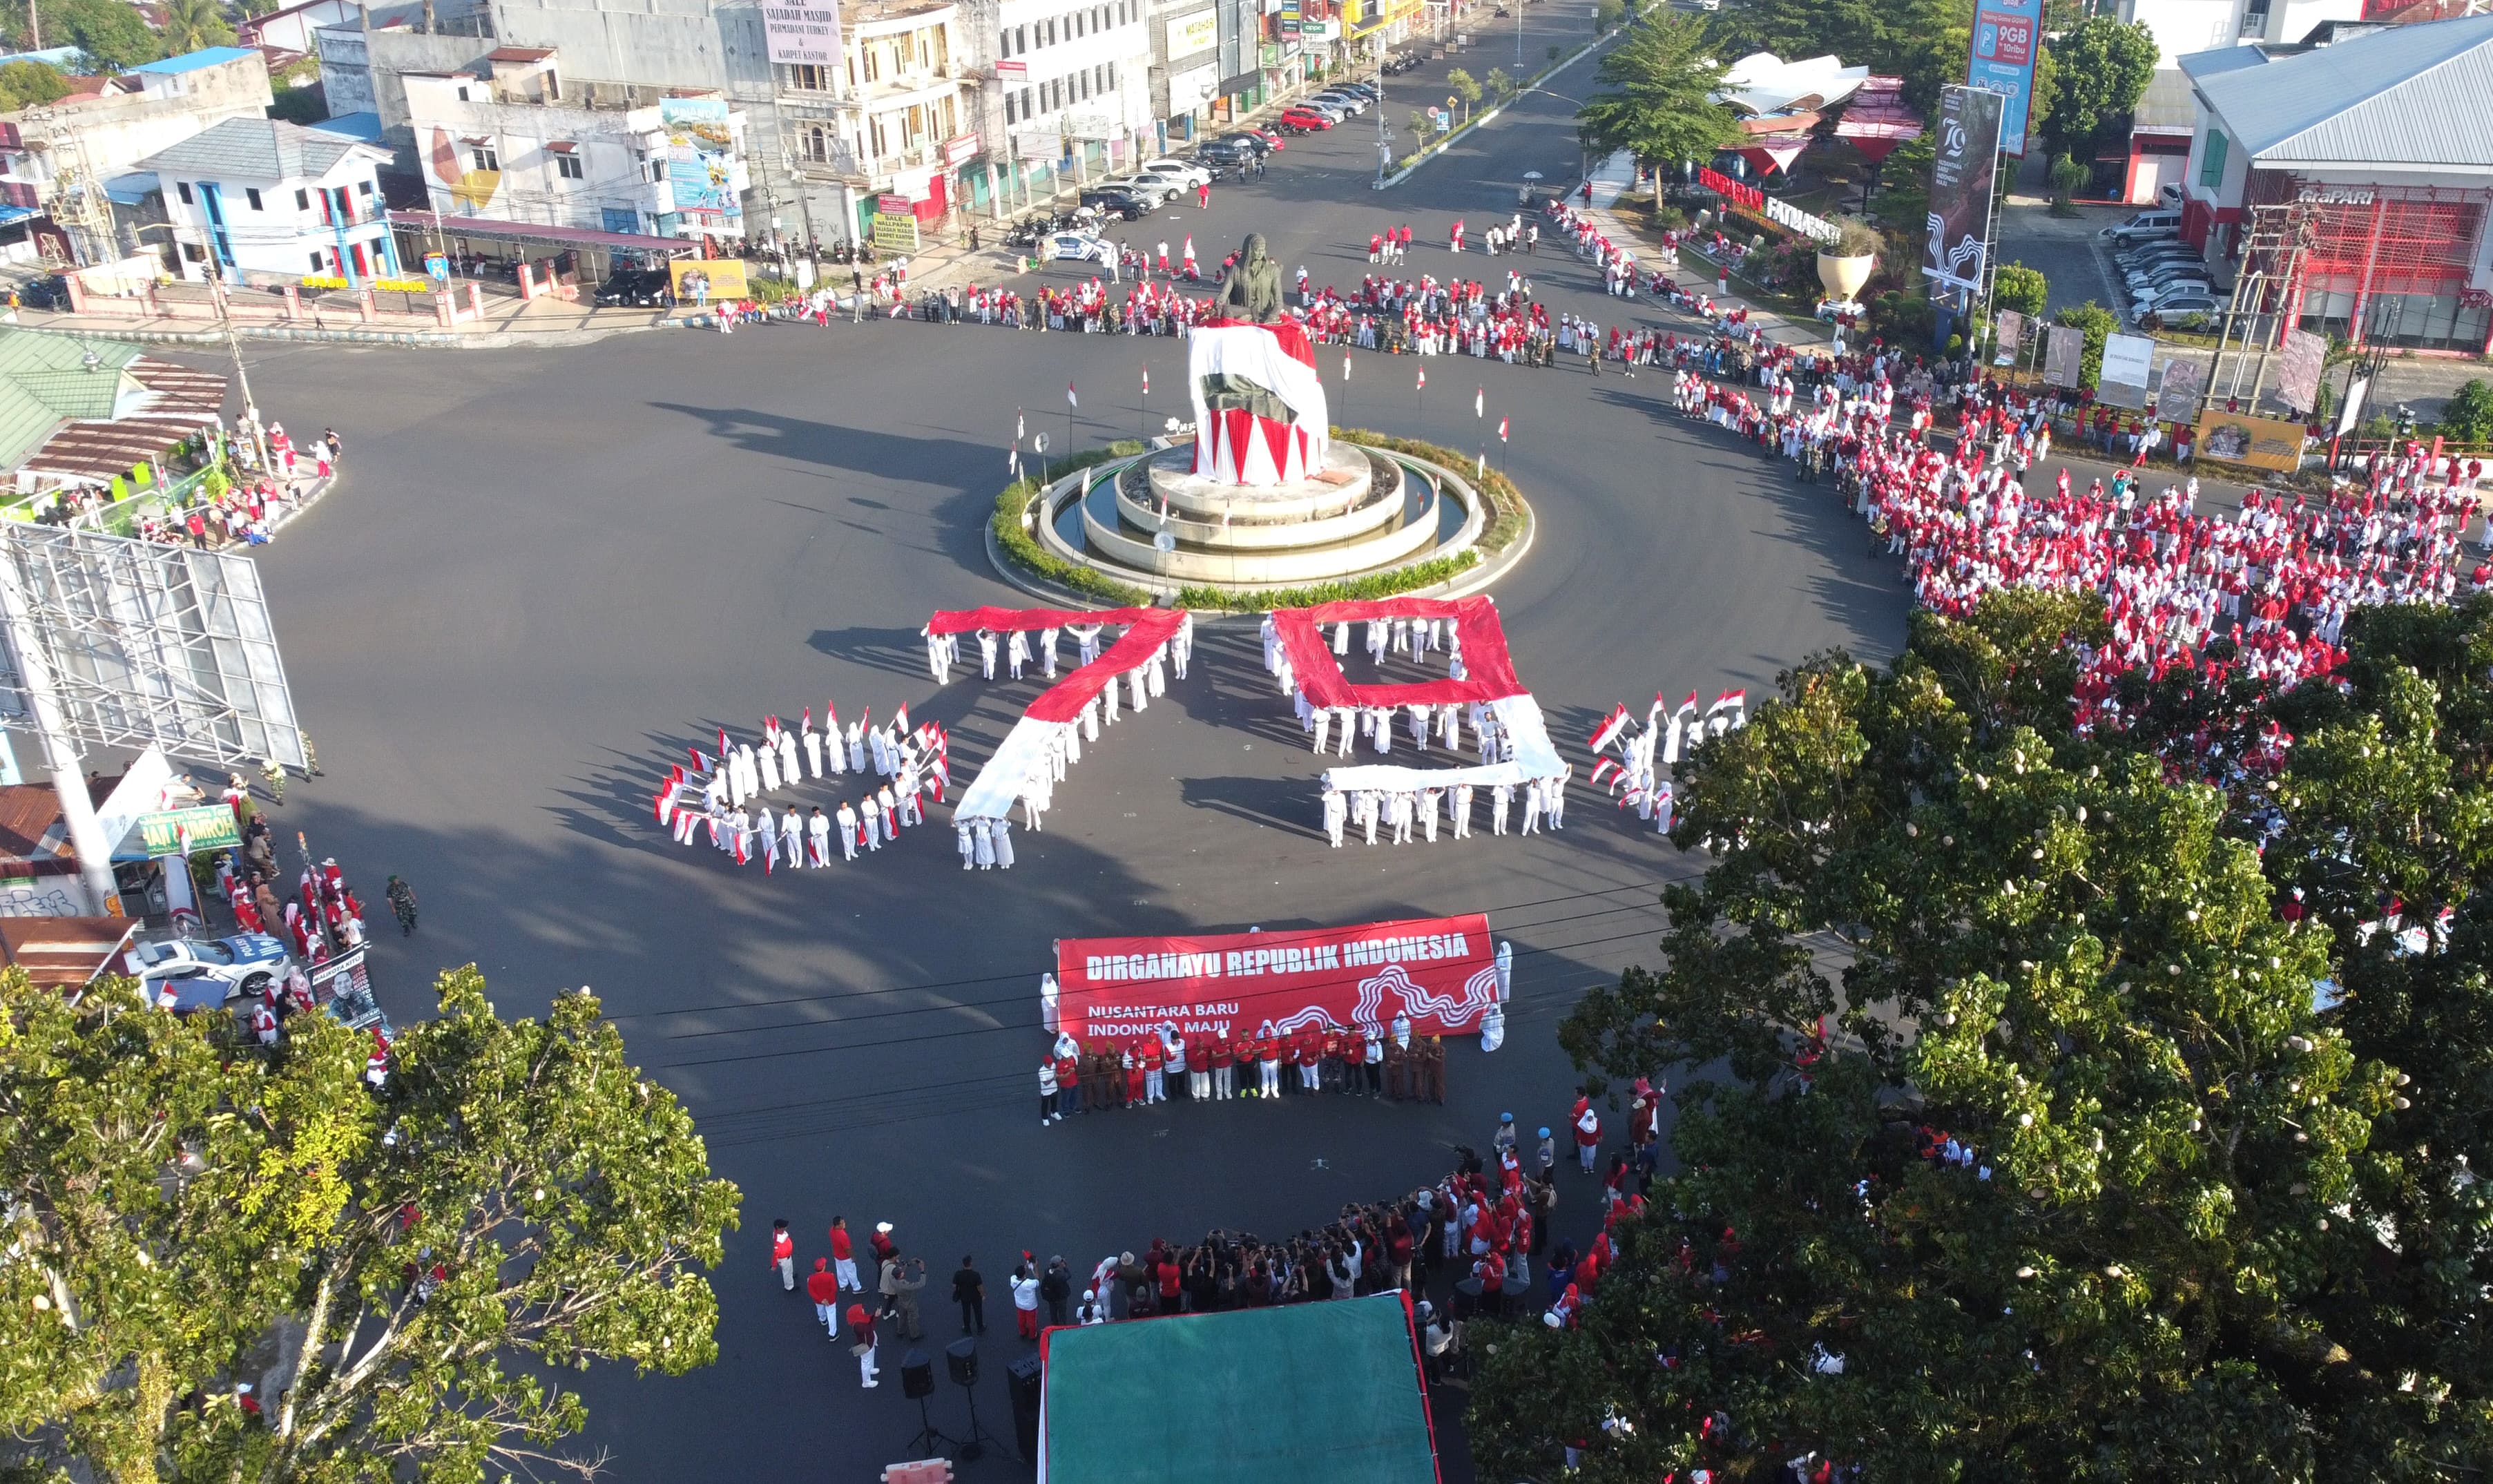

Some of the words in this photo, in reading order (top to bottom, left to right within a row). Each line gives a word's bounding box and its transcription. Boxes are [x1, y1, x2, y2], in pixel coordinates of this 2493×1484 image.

[767, 8, 801, 21] SAJADAH
[803, 10, 831, 23] MASJID
[770, 23, 805, 34] PERMADANI
[807, 25, 829, 35] TURKEY
[1999, 26, 2028, 44] 9GB
[778, 49, 801, 59] KARPET
[803, 50, 827, 61] KANTOR
[2003, 43, 2025, 55] 10ribu
[2298, 189, 2374, 205] GraPARI
[235, 938, 256, 956] POLISI
[1086, 953, 1220, 981] DIRGAHAYU
[1226, 945, 1340, 976] REPUBLIK
[1343, 932, 1469, 967] INDONESIA
[1088, 1004, 1191, 1019] NUSANTARA
[1195, 1002, 1239, 1016] BARU
[1087, 1023, 1180, 1037] INDONESA
[1184, 1019, 1230, 1033] MAJU
